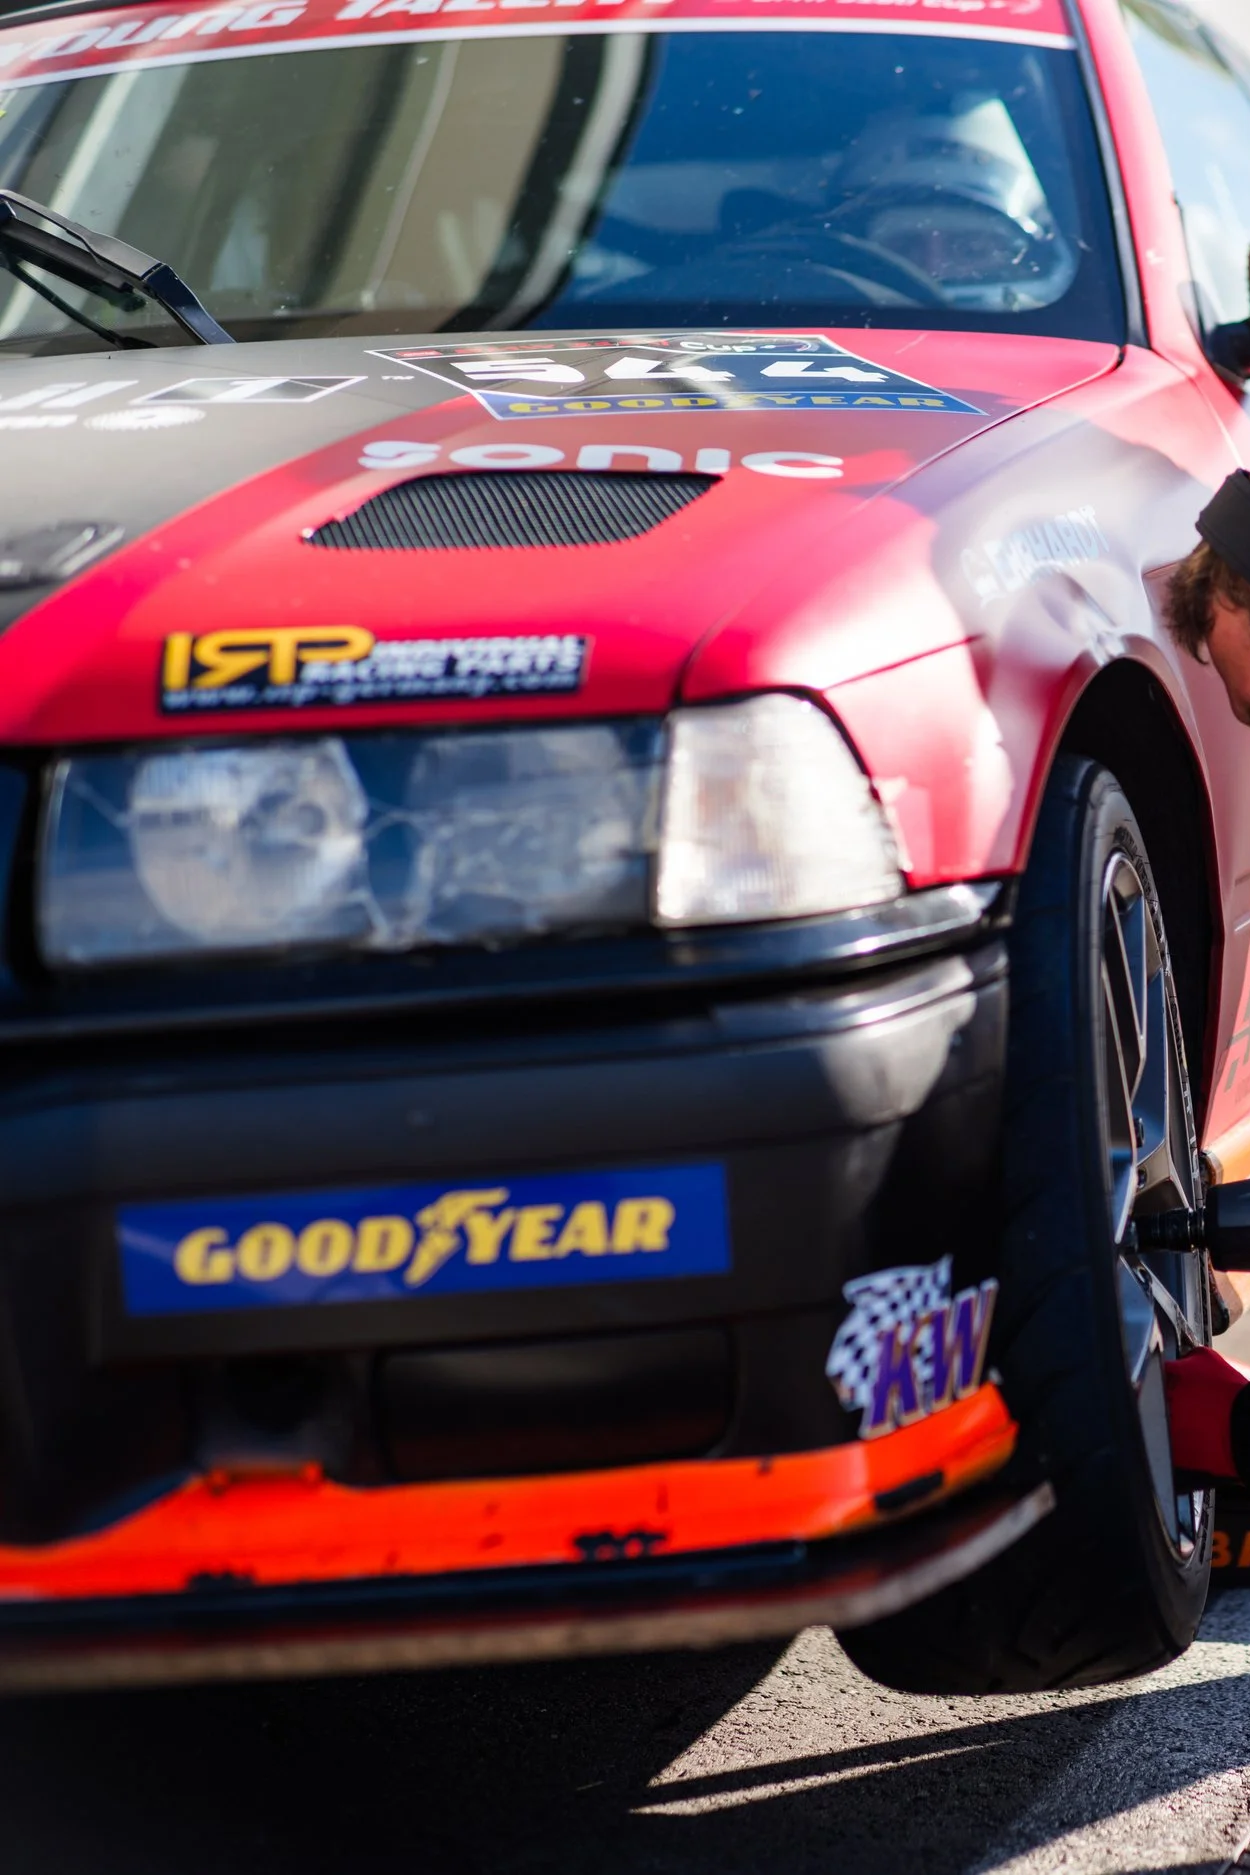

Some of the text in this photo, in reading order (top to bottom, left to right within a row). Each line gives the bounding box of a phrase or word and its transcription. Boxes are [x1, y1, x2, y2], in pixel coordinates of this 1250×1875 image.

[679, 339, 757, 353] Cup
[508, 392, 947, 413] GOODYEAR
[357, 440, 844, 479] sonic
[173, 1187, 676, 1287] GOODYEAR
[859, 1277, 999, 1441] KW
